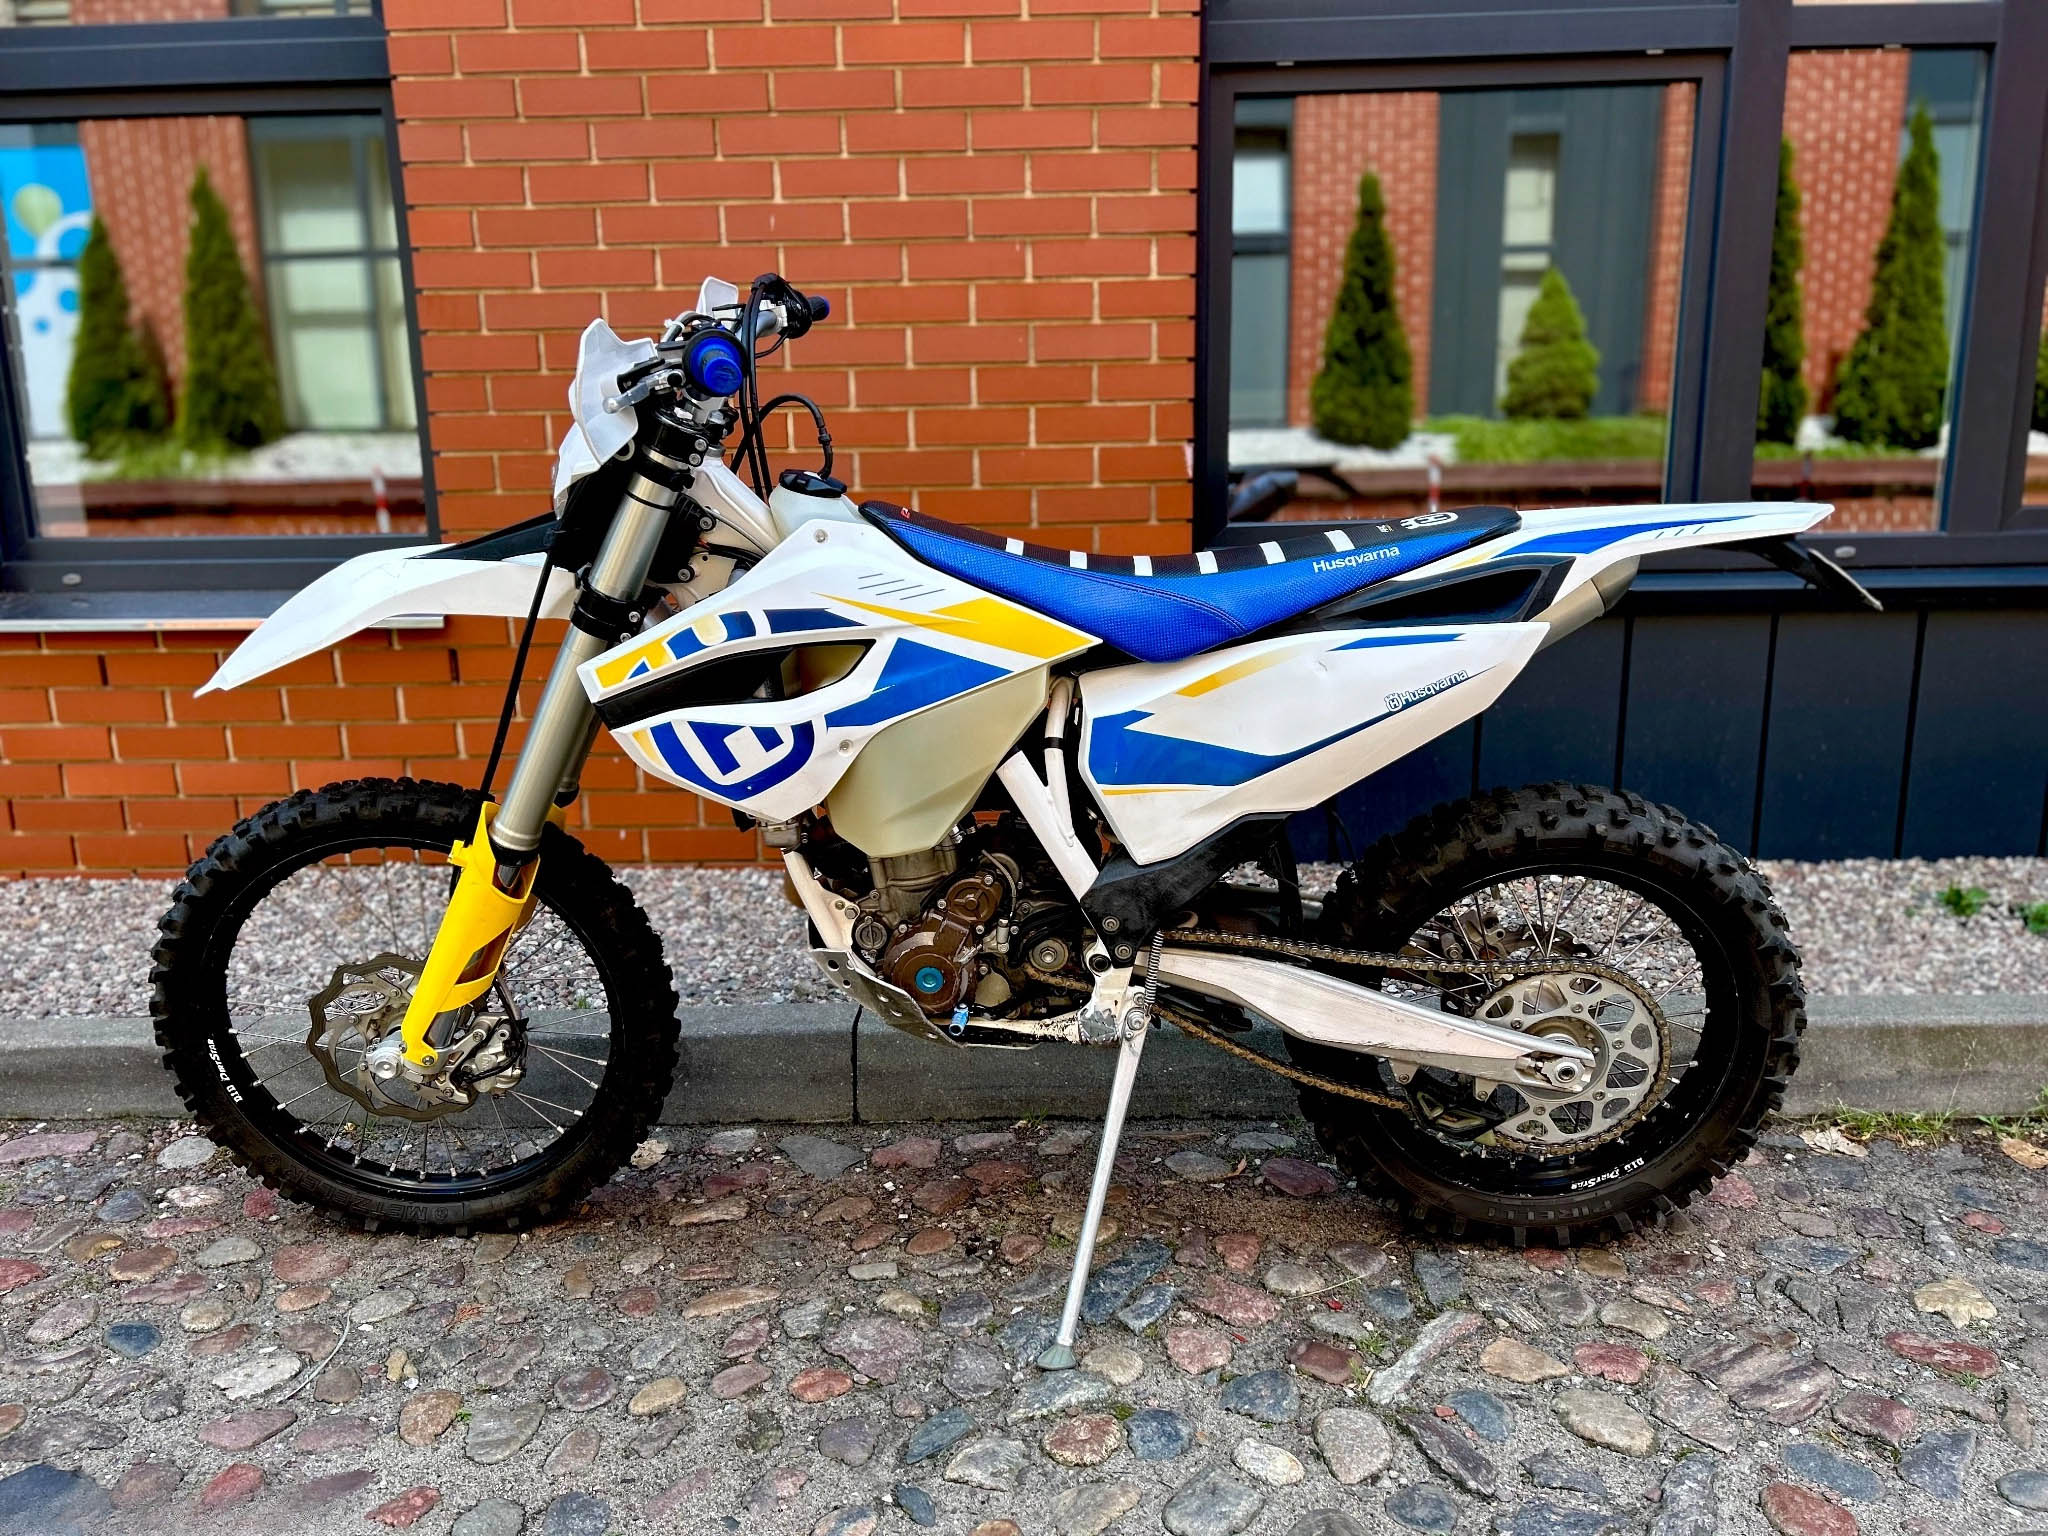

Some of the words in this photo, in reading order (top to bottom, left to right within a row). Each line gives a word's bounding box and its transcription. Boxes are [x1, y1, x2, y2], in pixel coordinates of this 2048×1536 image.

[1312, 546, 1400, 573] Husqvarna
[1400, 670, 1468, 705] Husqvarna
[281, 1166, 428, 1221] METZELER
